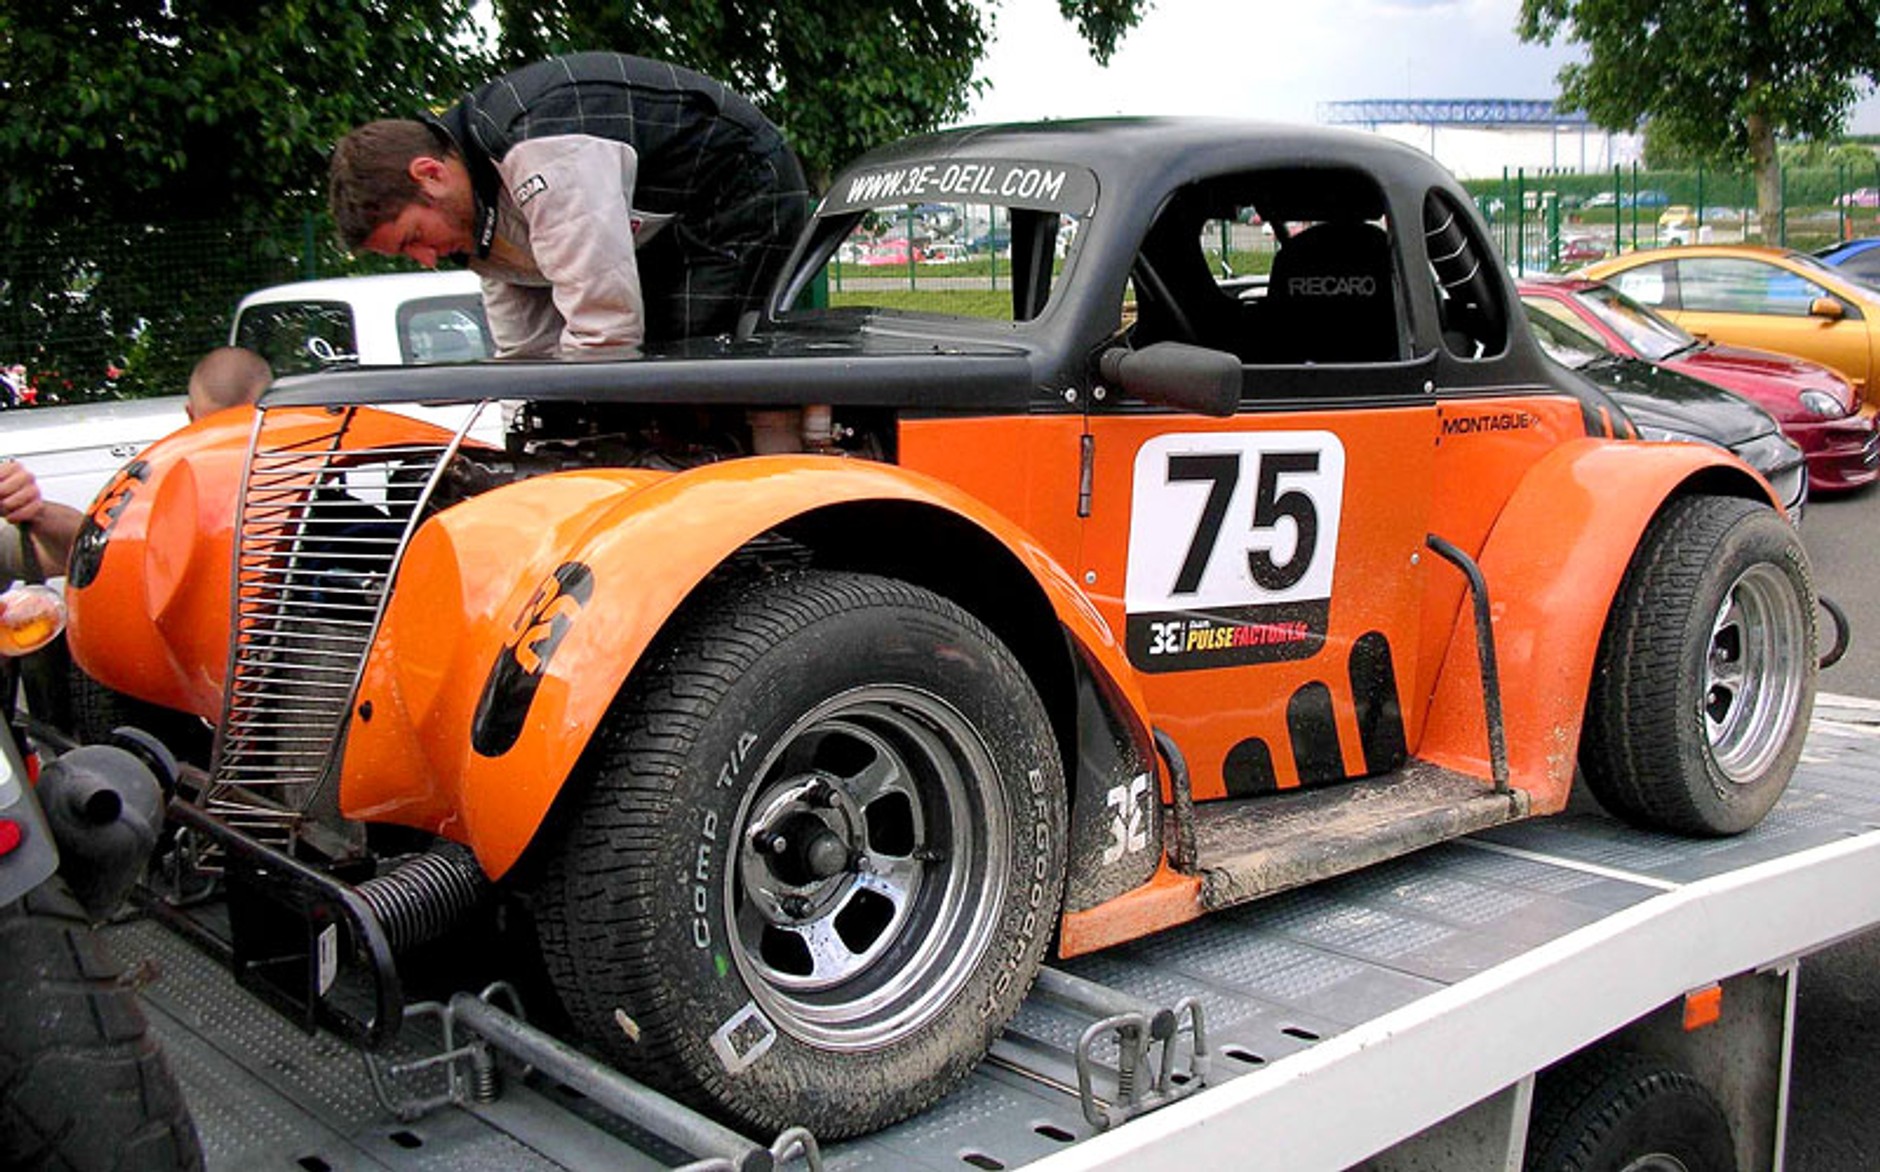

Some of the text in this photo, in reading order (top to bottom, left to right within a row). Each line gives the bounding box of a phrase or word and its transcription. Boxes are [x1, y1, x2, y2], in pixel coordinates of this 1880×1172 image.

[846, 163, 1067, 203] WWW.3E-OEIL.COM
[1288, 275, 1376, 297] RECARO
[1443, 413, 1530, 435] MONTAGUE
[1164, 450, 1321, 597] 75
[692, 730, 759, 949] COMP T/A
